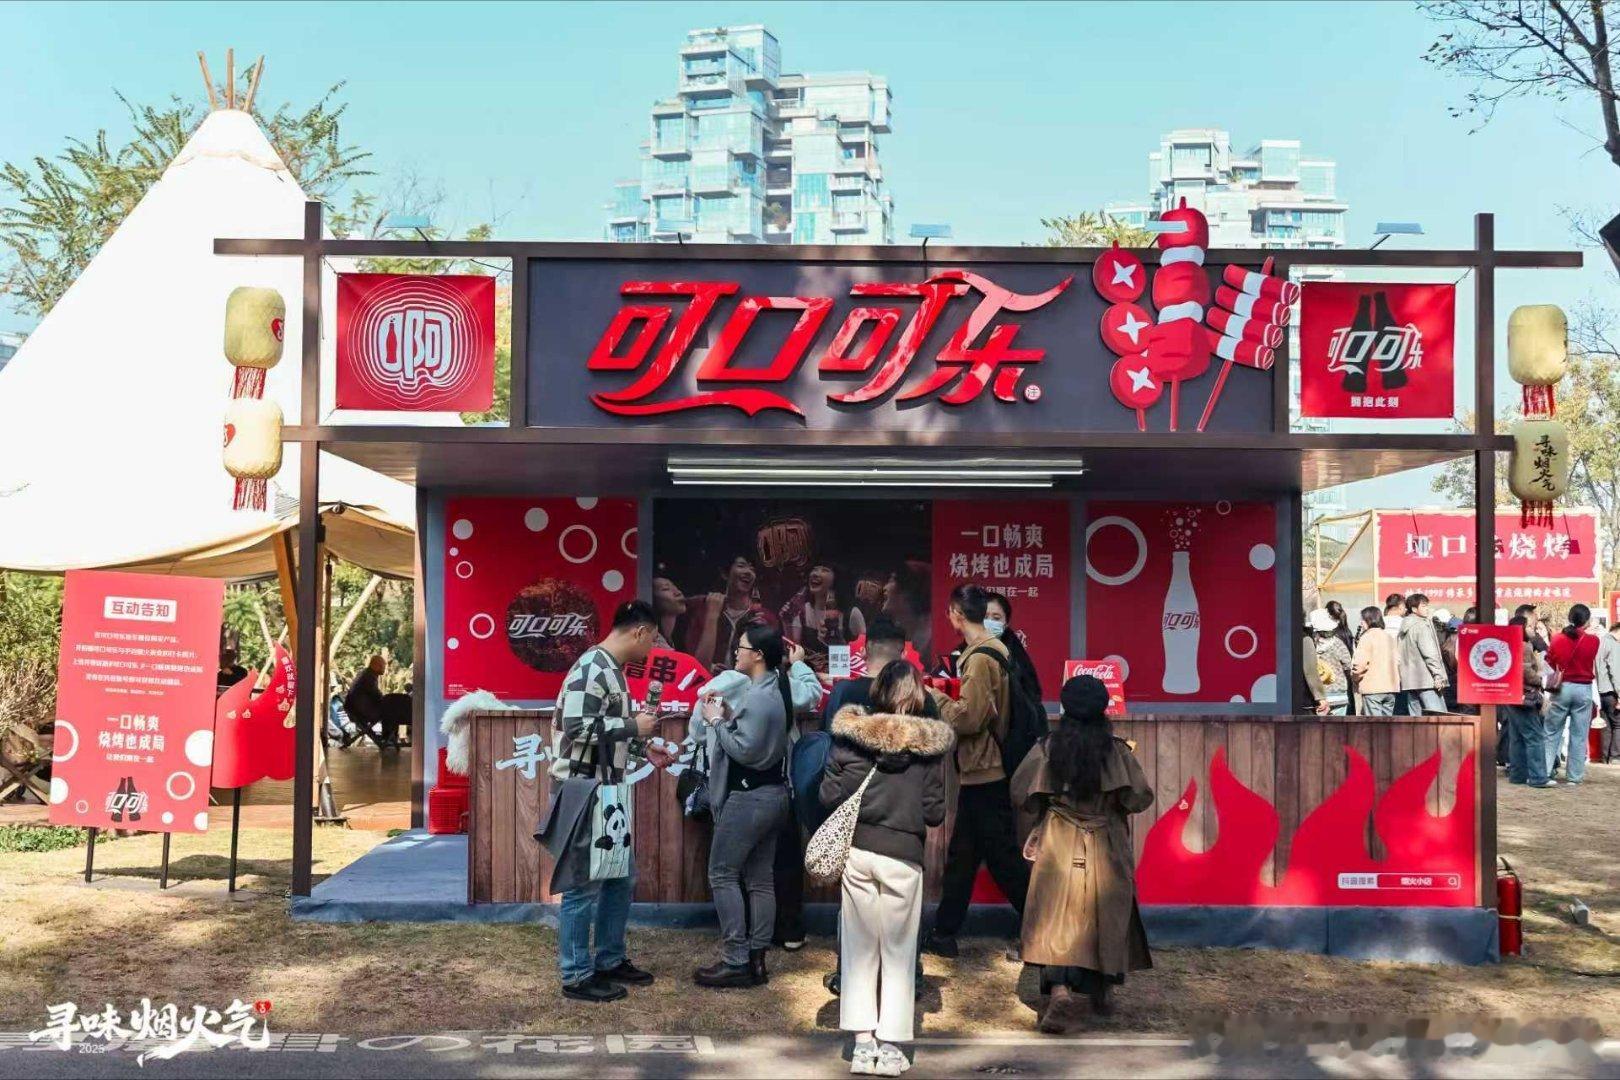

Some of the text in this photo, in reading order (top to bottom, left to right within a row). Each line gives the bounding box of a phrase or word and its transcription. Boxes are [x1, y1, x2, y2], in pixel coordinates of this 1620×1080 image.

[587, 270, 1074, 417] 可口可乐
[1327, 322, 1424, 375] 可口可乐
[960, 523, 1044, 548] 一口畅爽
[1404, 532, 1571, 559] 垭口烧烤
[949, 553, 1054, 579] 烧烤也成局
[111, 600, 171, 617] 互动告知
[509, 612, 592, 638] 可口可乐
[106, 714, 160, 731] 一口畅爽
[98, 731, 165, 752] 烧烤也成局
